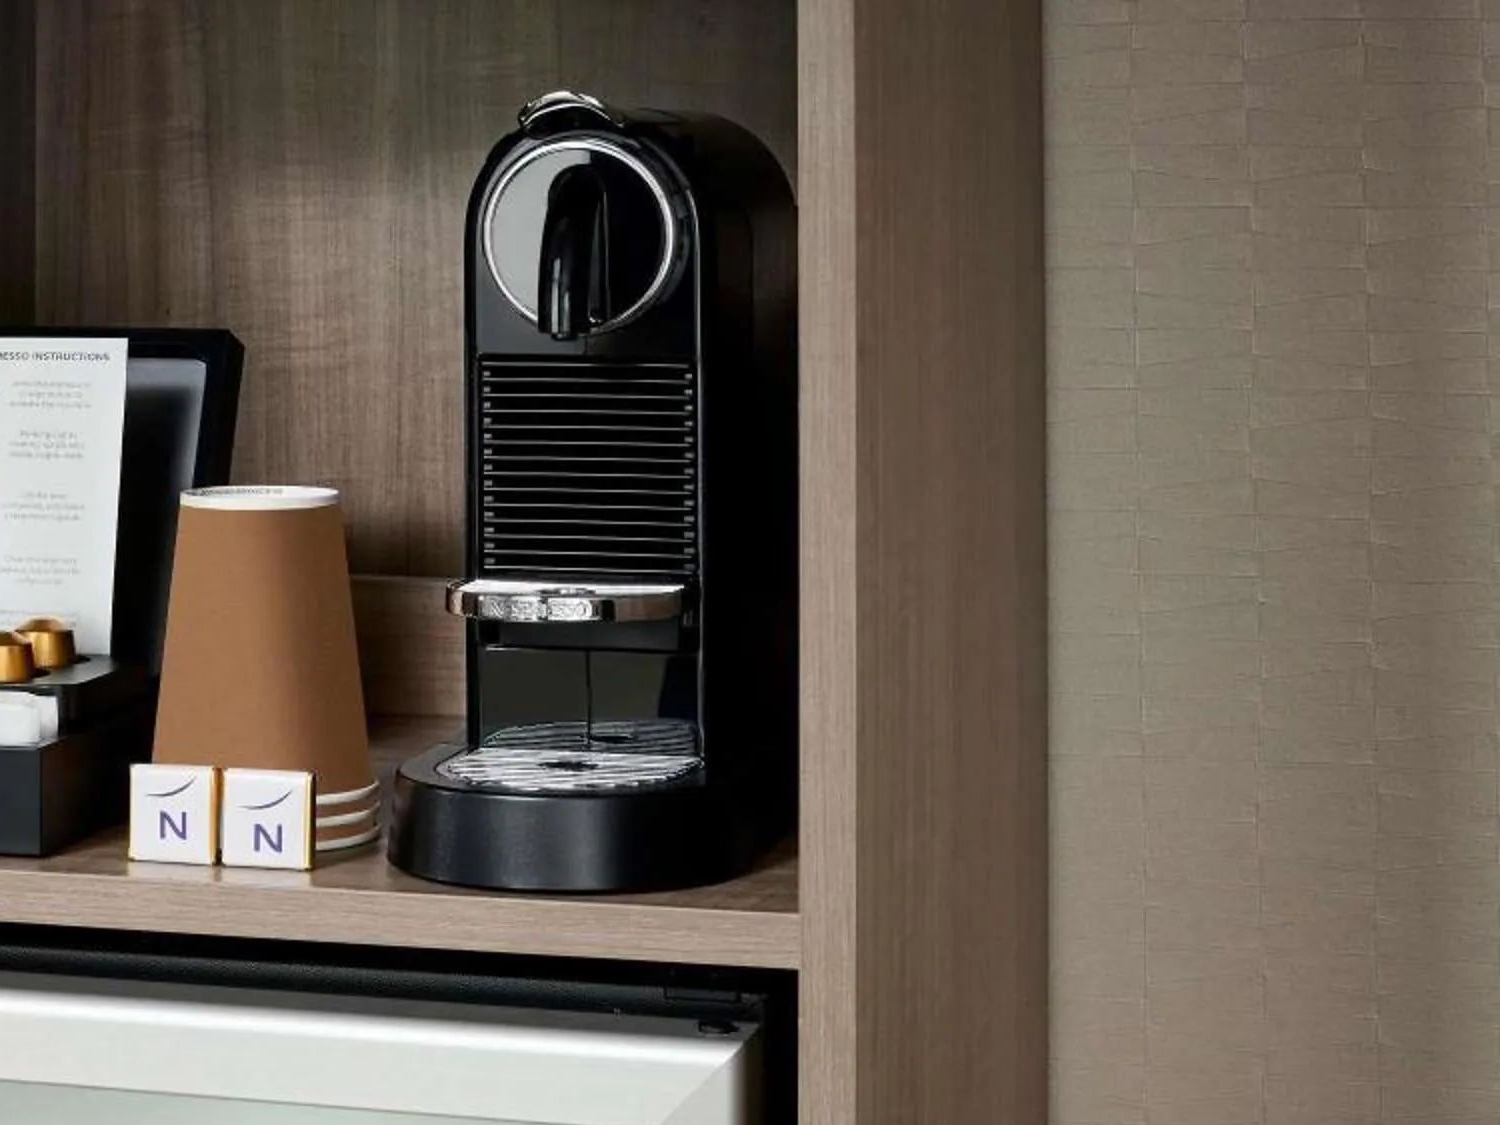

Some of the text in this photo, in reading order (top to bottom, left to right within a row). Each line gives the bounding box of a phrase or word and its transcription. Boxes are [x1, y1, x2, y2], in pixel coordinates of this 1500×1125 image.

[31, 351, 110, 362] INSTRUCTIONS
[159, 810, 188, 841] N
[253, 823, 283, 853] N
